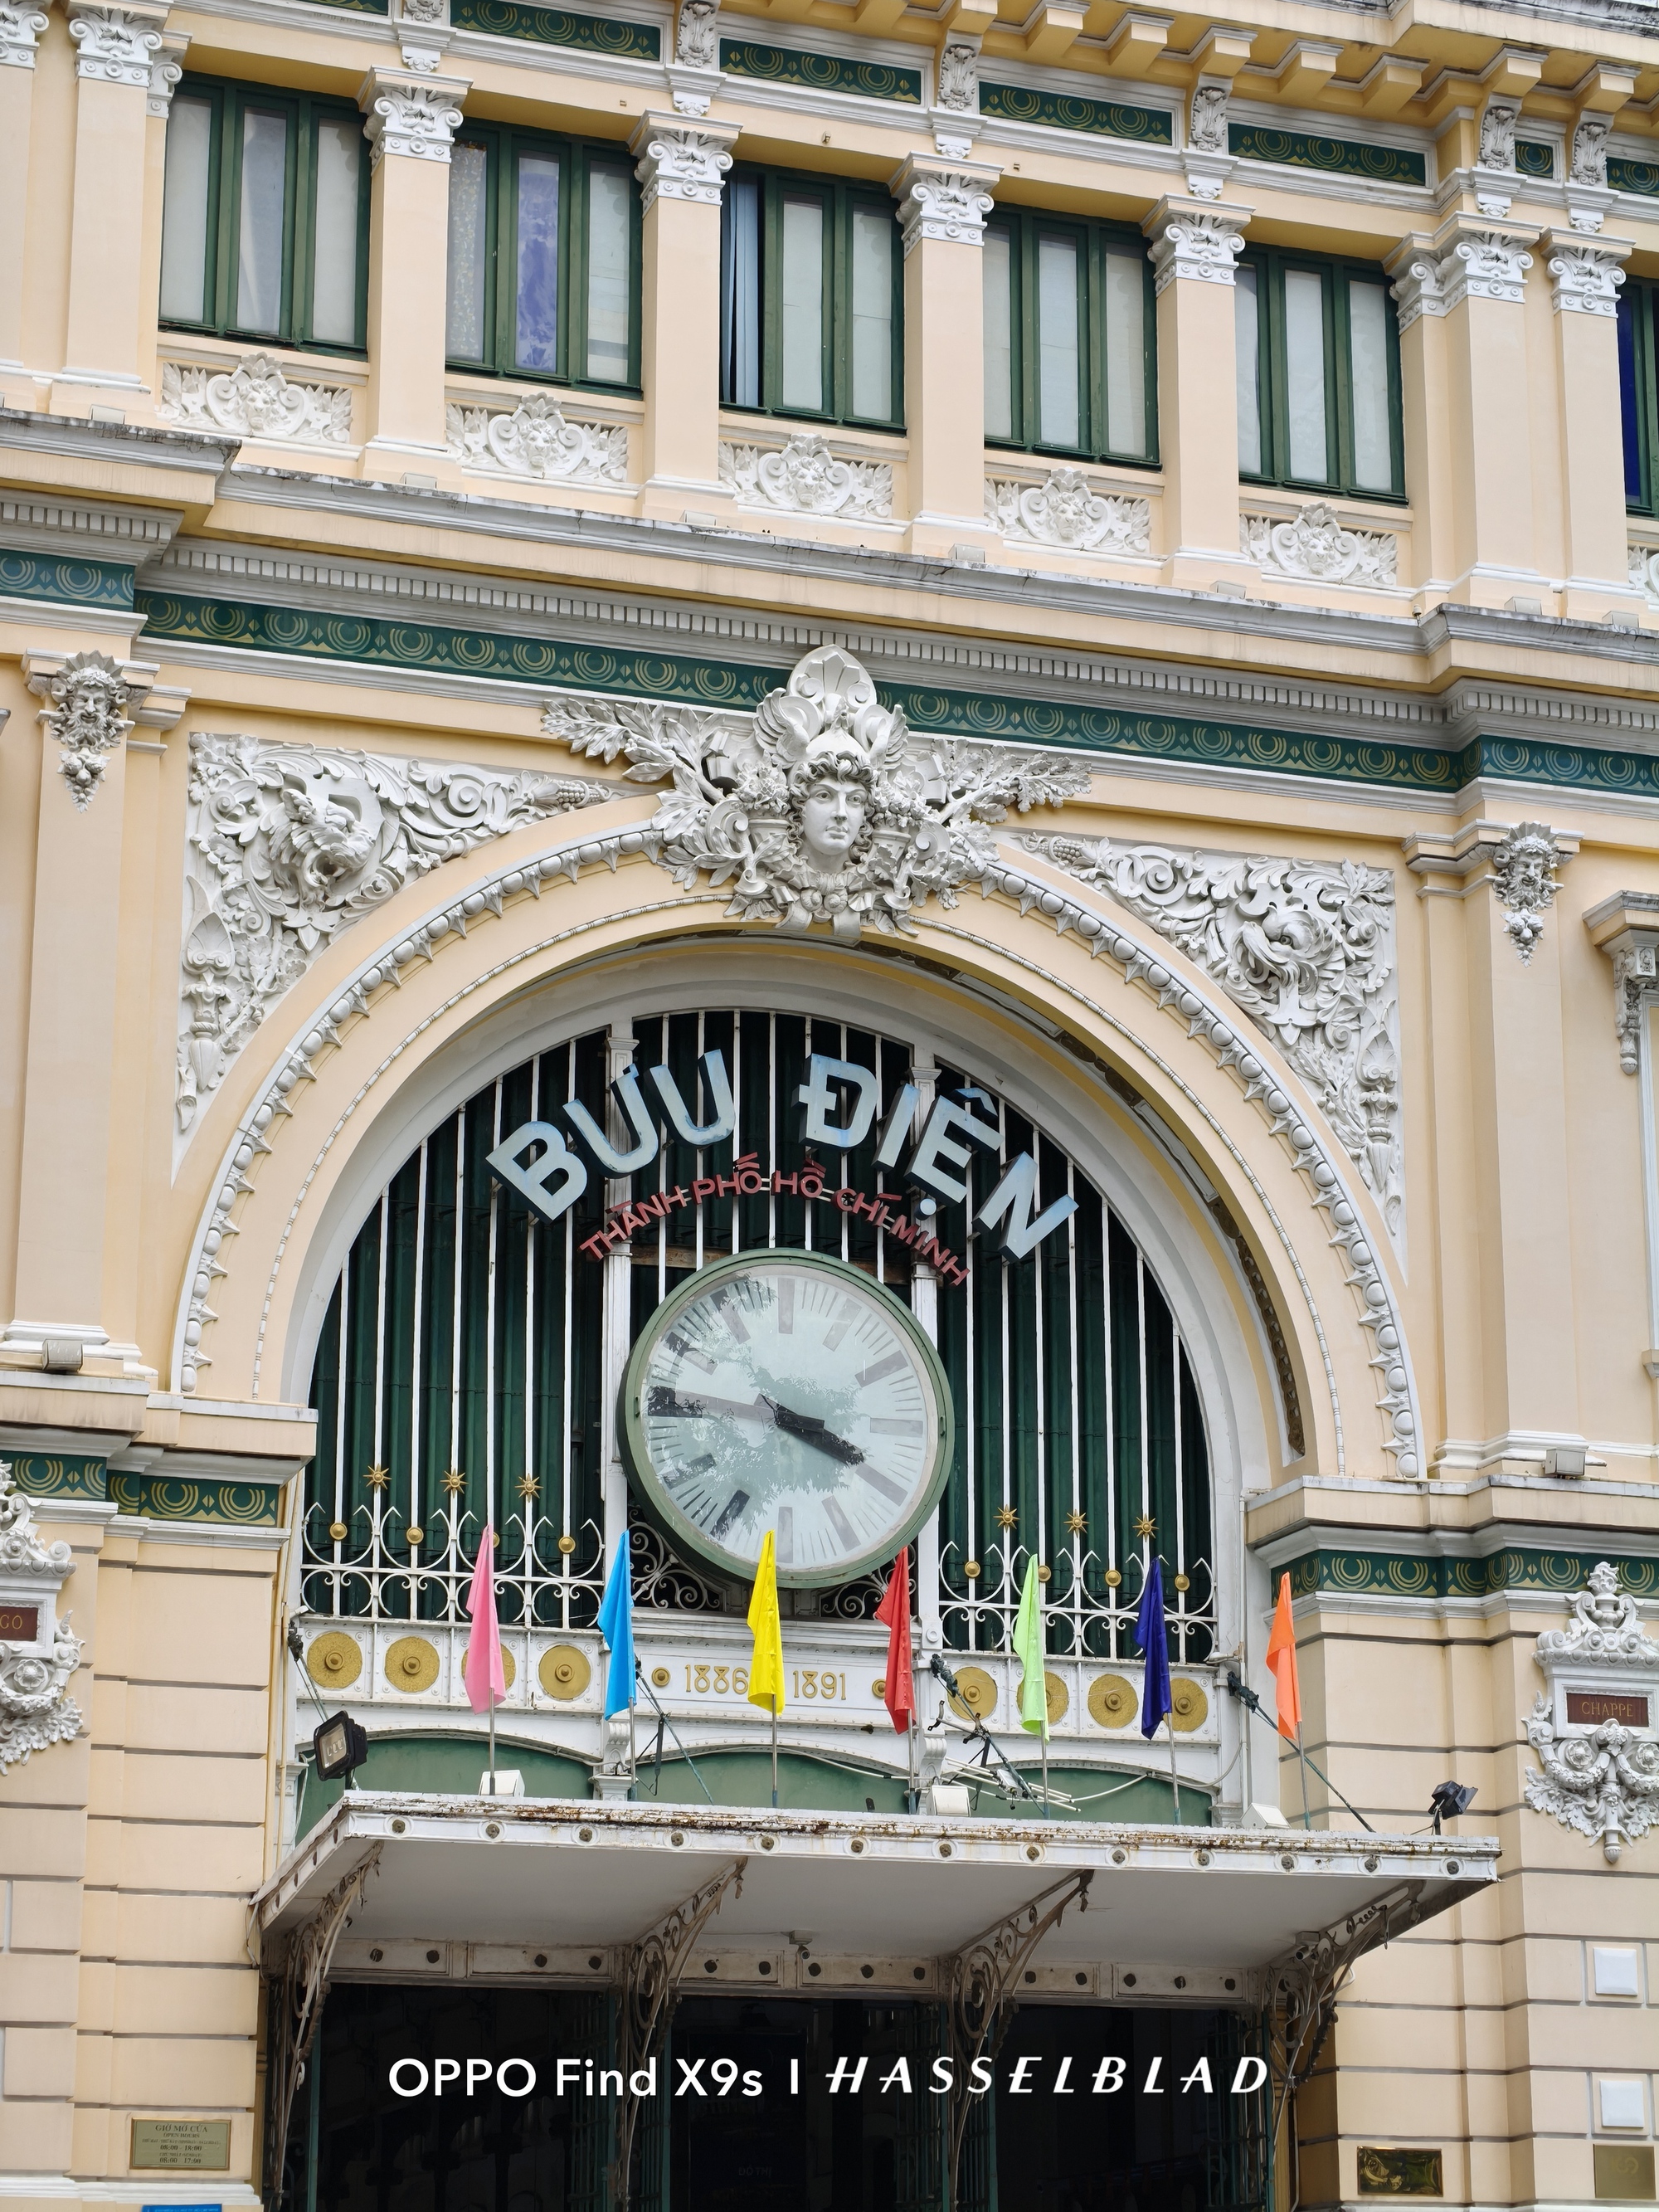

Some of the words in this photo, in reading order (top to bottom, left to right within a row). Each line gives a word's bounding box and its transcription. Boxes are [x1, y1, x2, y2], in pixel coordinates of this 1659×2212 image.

[485, 1049, 737, 1222] BƯU
[791, 1053, 1080, 1261] ĐIỆN
[579, 1185, 688, 1261] THÀNH
[692, 1152, 762, 1205] PHỐ
[771, 1157, 826, 1199] HỒ
[831, 1188, 902, 1227] CHÍ
[888, 1214, 971, 1286] MINH
[684, 1664, 749, 1695] 1886
[792, 1669, 846, 1701] 1891
[1581, 1701, 1633, 1717] CHAPPE
